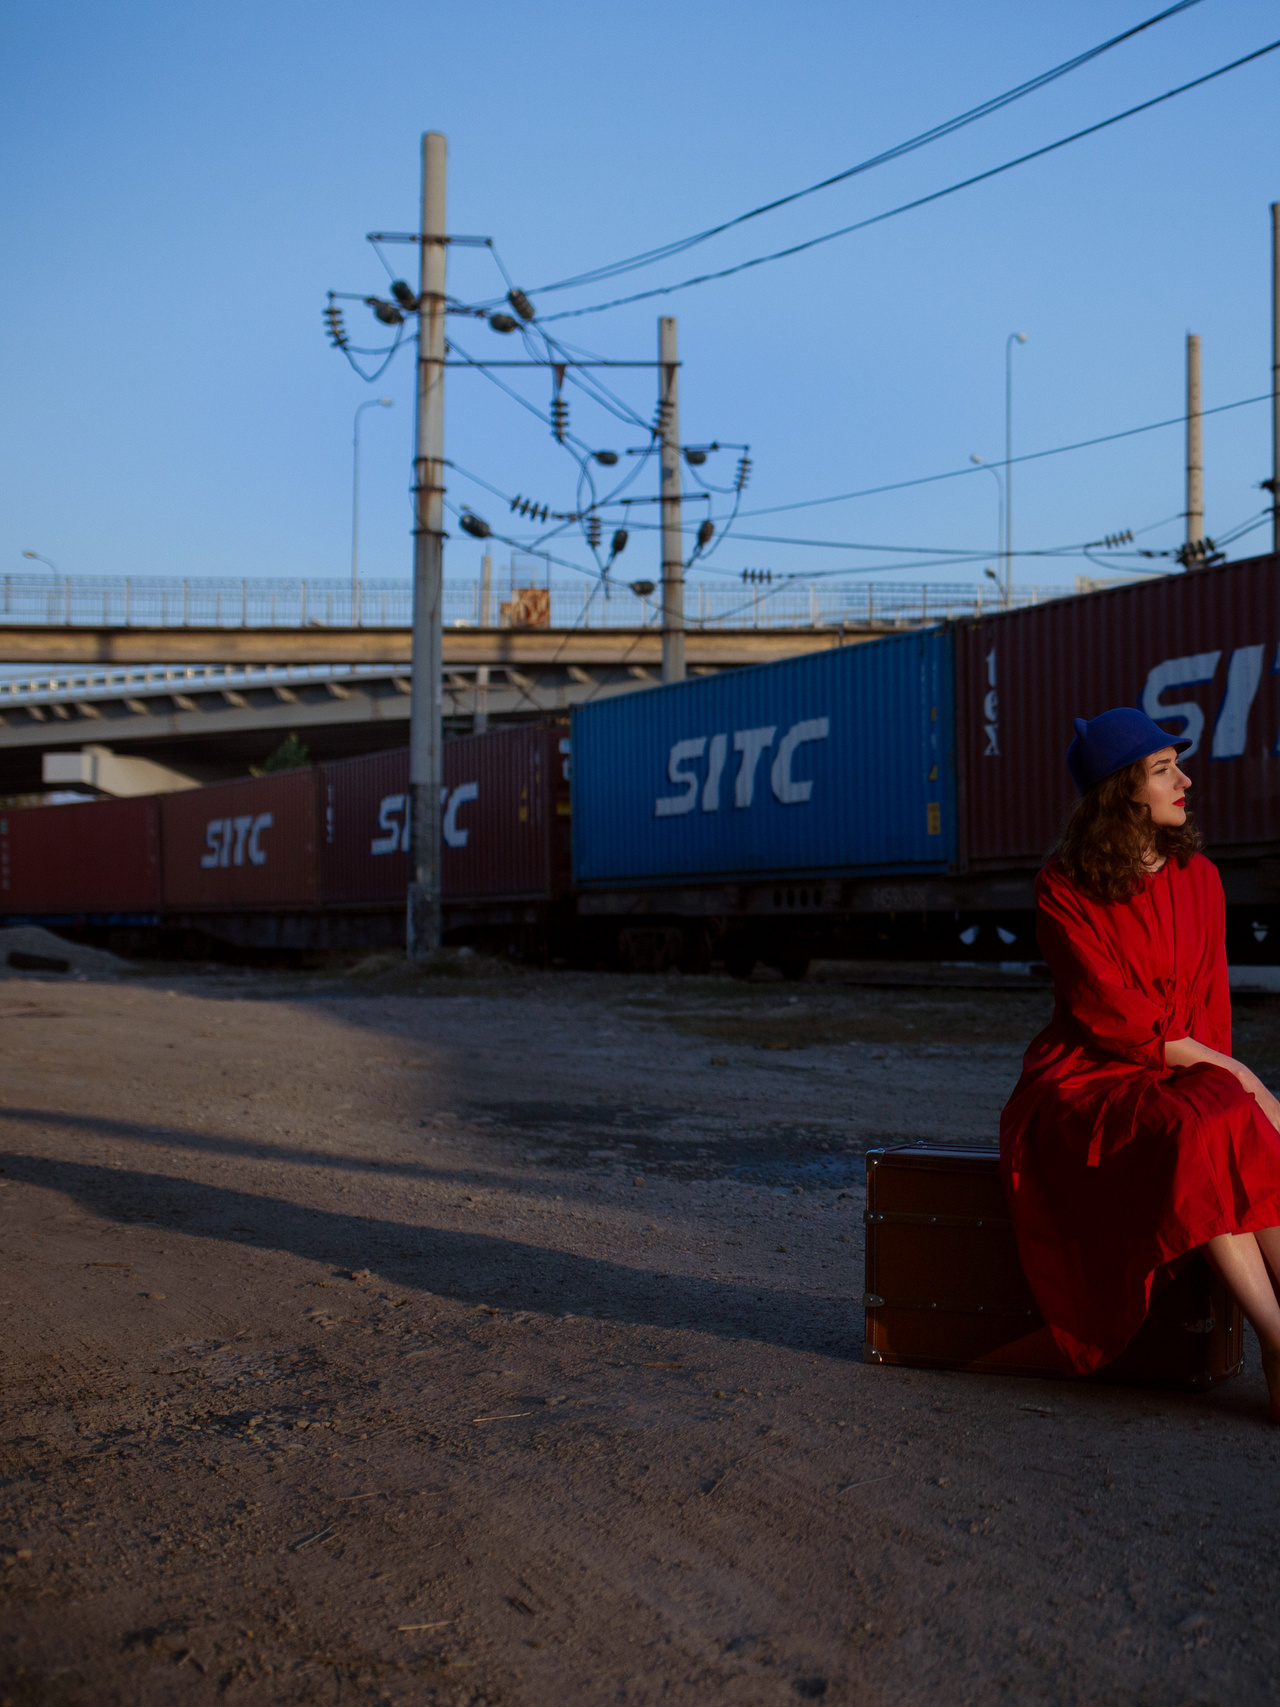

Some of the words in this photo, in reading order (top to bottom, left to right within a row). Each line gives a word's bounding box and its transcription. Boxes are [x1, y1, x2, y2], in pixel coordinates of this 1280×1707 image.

[983, 647, 1001, 757] tex
[653, 716, 831, 818] SITC
[199, 812, 274, 870] SITC
